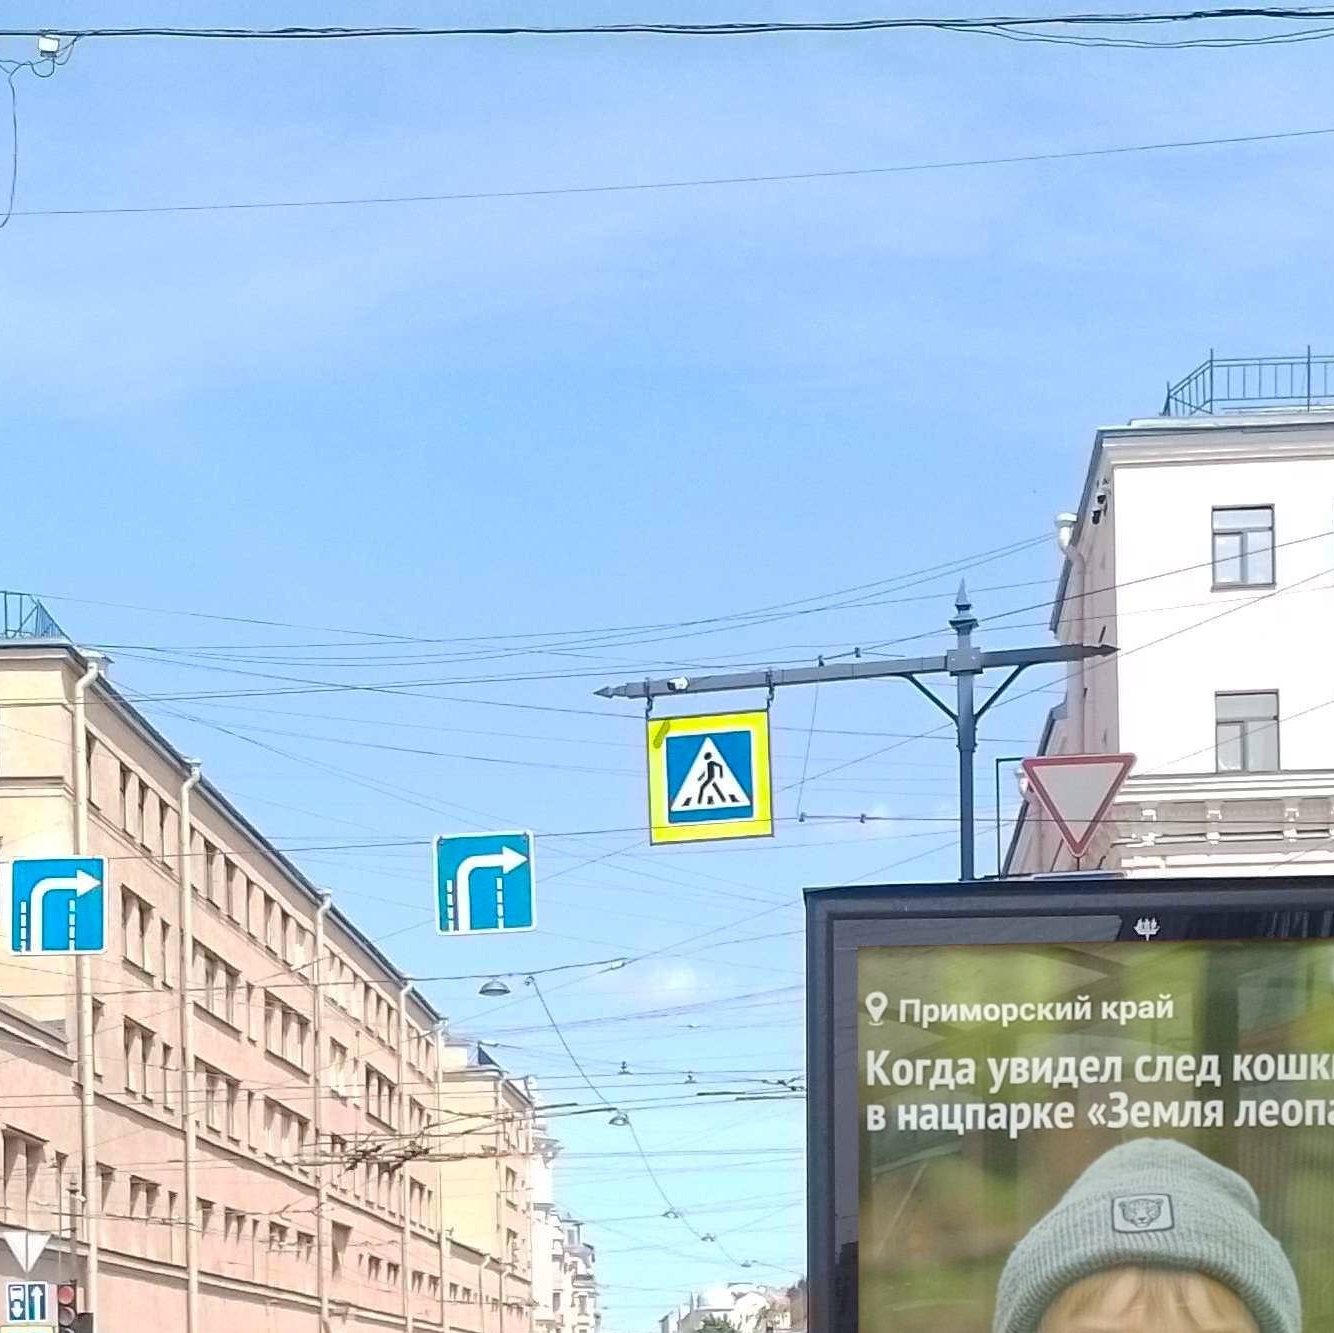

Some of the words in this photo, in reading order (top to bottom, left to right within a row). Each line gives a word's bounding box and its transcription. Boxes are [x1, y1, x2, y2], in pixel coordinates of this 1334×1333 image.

[898, 994, 1092, 1028] Приморский
[1101, 993, 1174, 1025] край
[866, 1049, 976, 1091] Когда
[986, 1054, 1122, 1094] увидел
[1134, 1053, 1221, 1088] след
[866, 1103, 886, 1131] в
[897, 1100, 1075, 1139] нацпарке
[1086, 1090, 1224, 1129] «Земля
